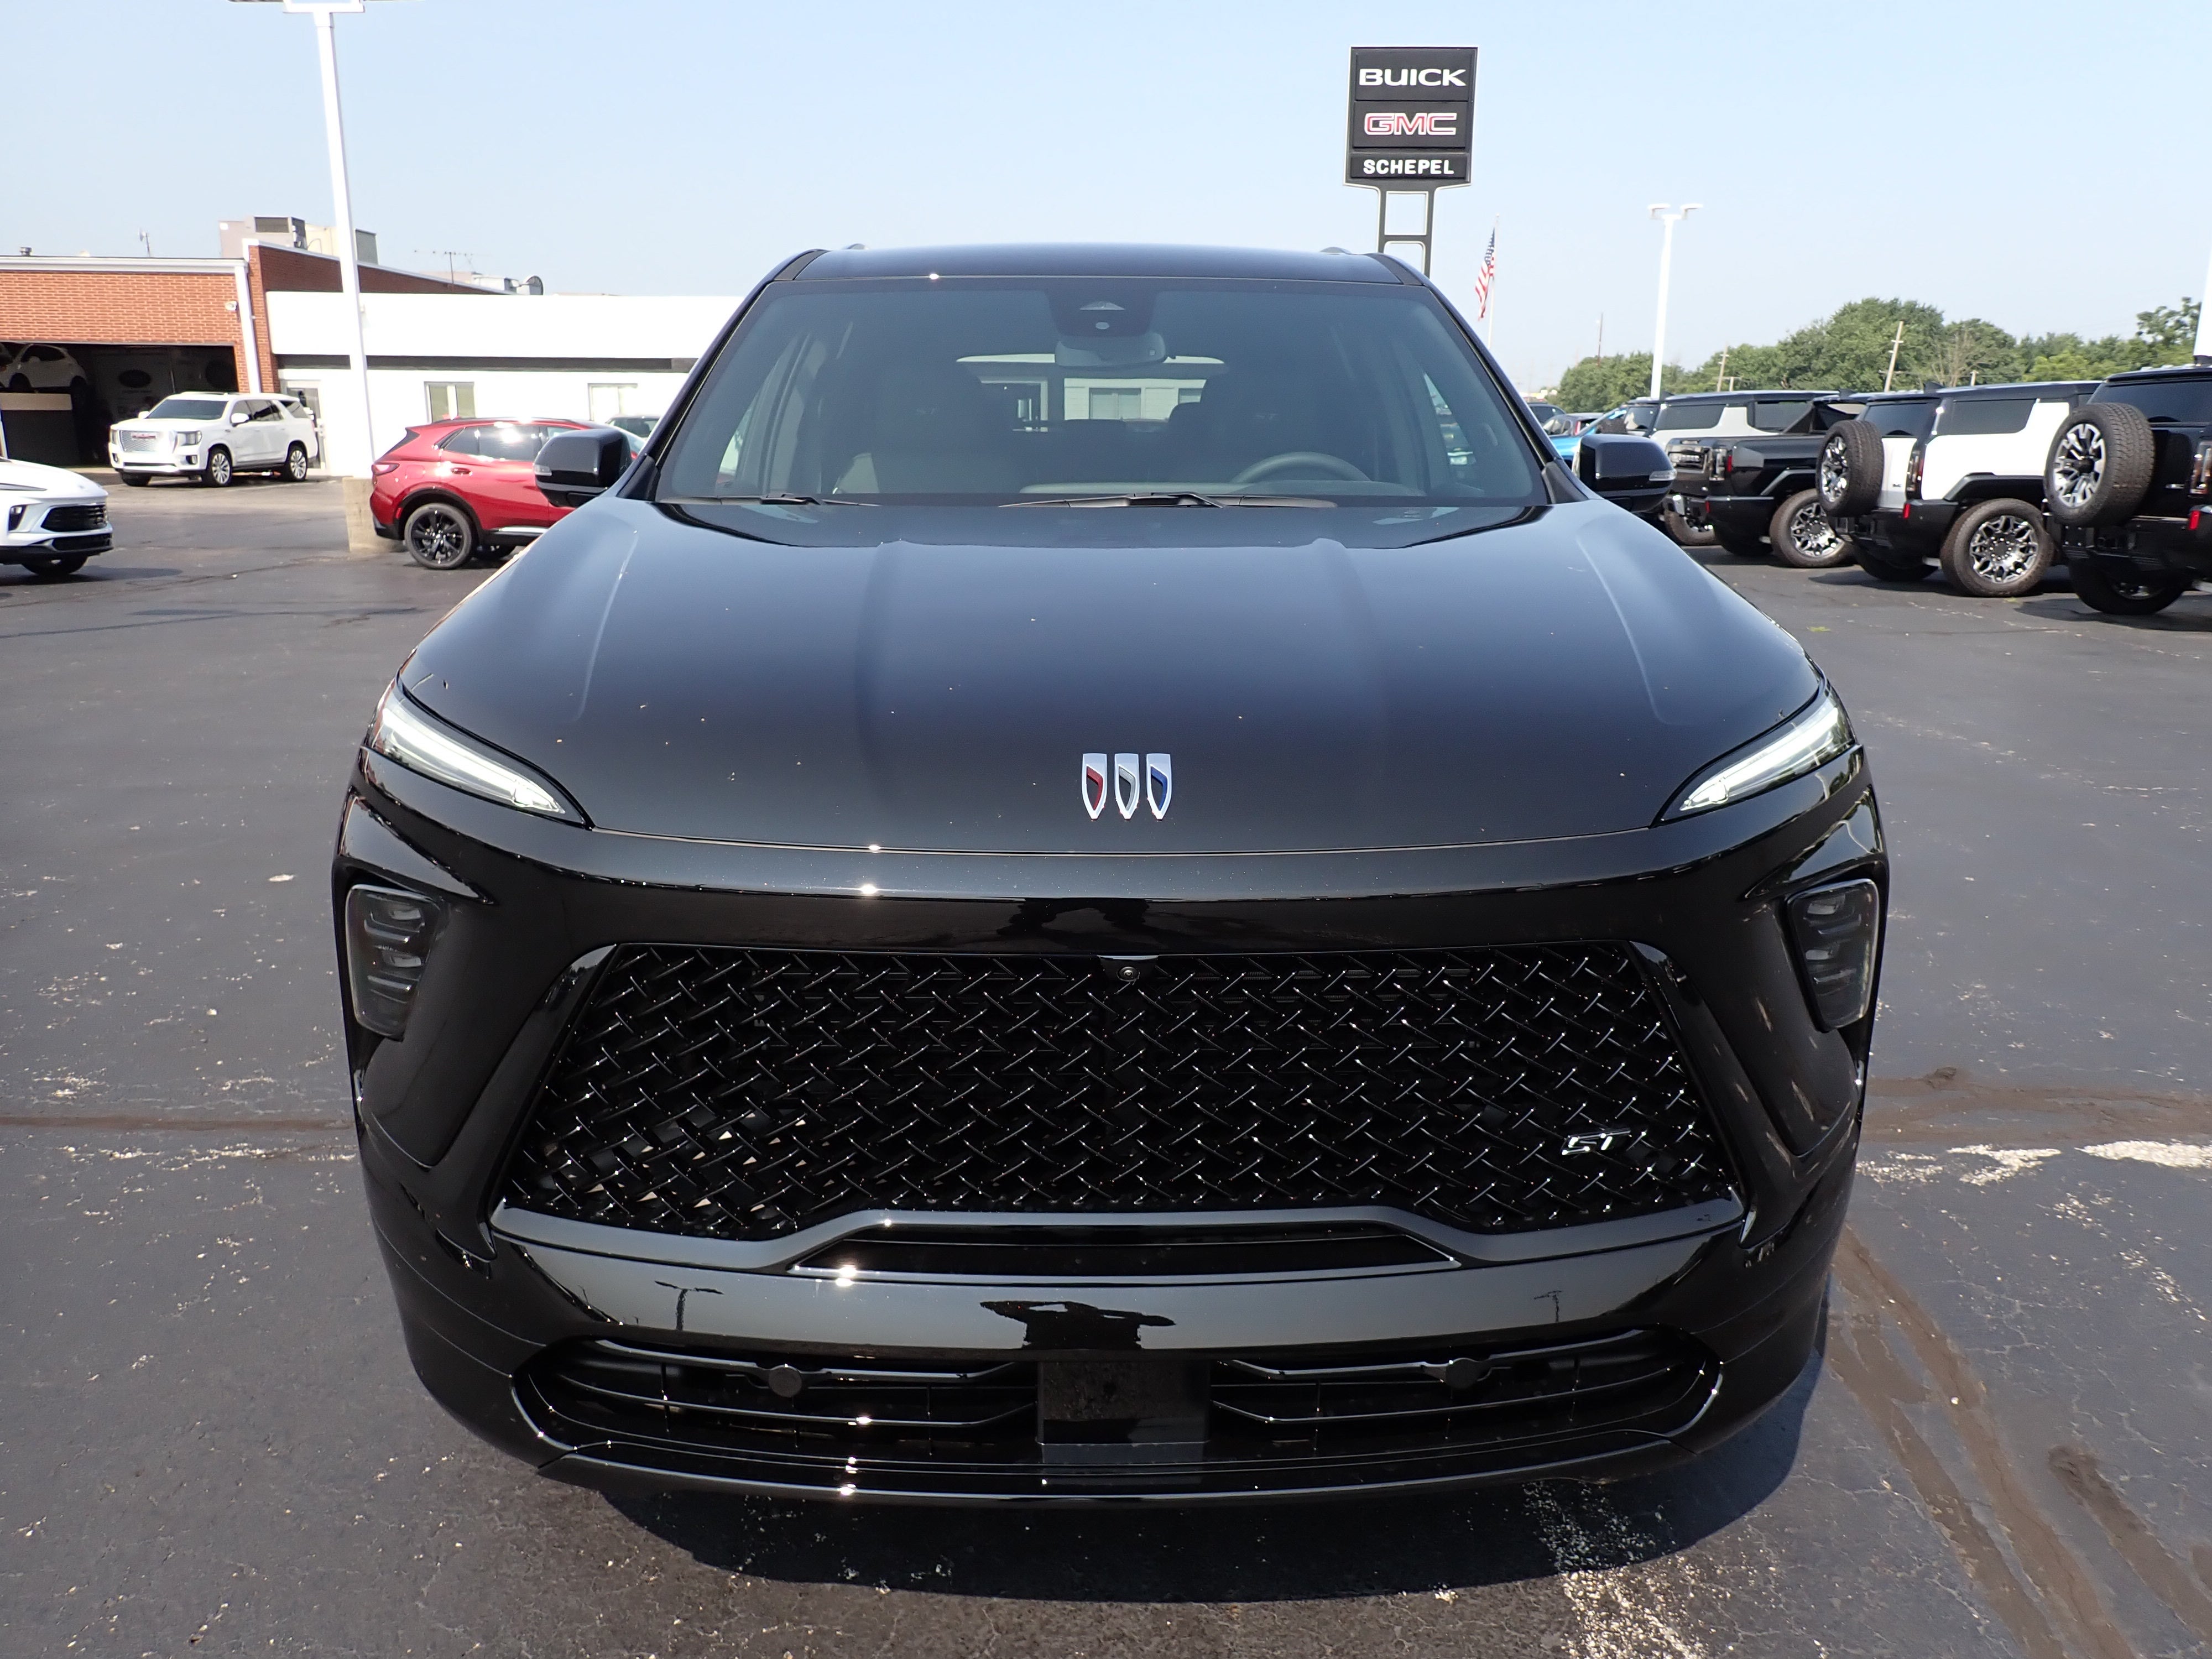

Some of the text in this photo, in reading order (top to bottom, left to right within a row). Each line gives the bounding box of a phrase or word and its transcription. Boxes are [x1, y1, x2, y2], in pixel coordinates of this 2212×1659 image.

[1359, 69, 1467, 86] BUICK
[1364, 112, 1457, 135] GMC
[1363, 159, 1454, 174] SCHEPEL
[1561, 1129, 1631, 1155] ST
